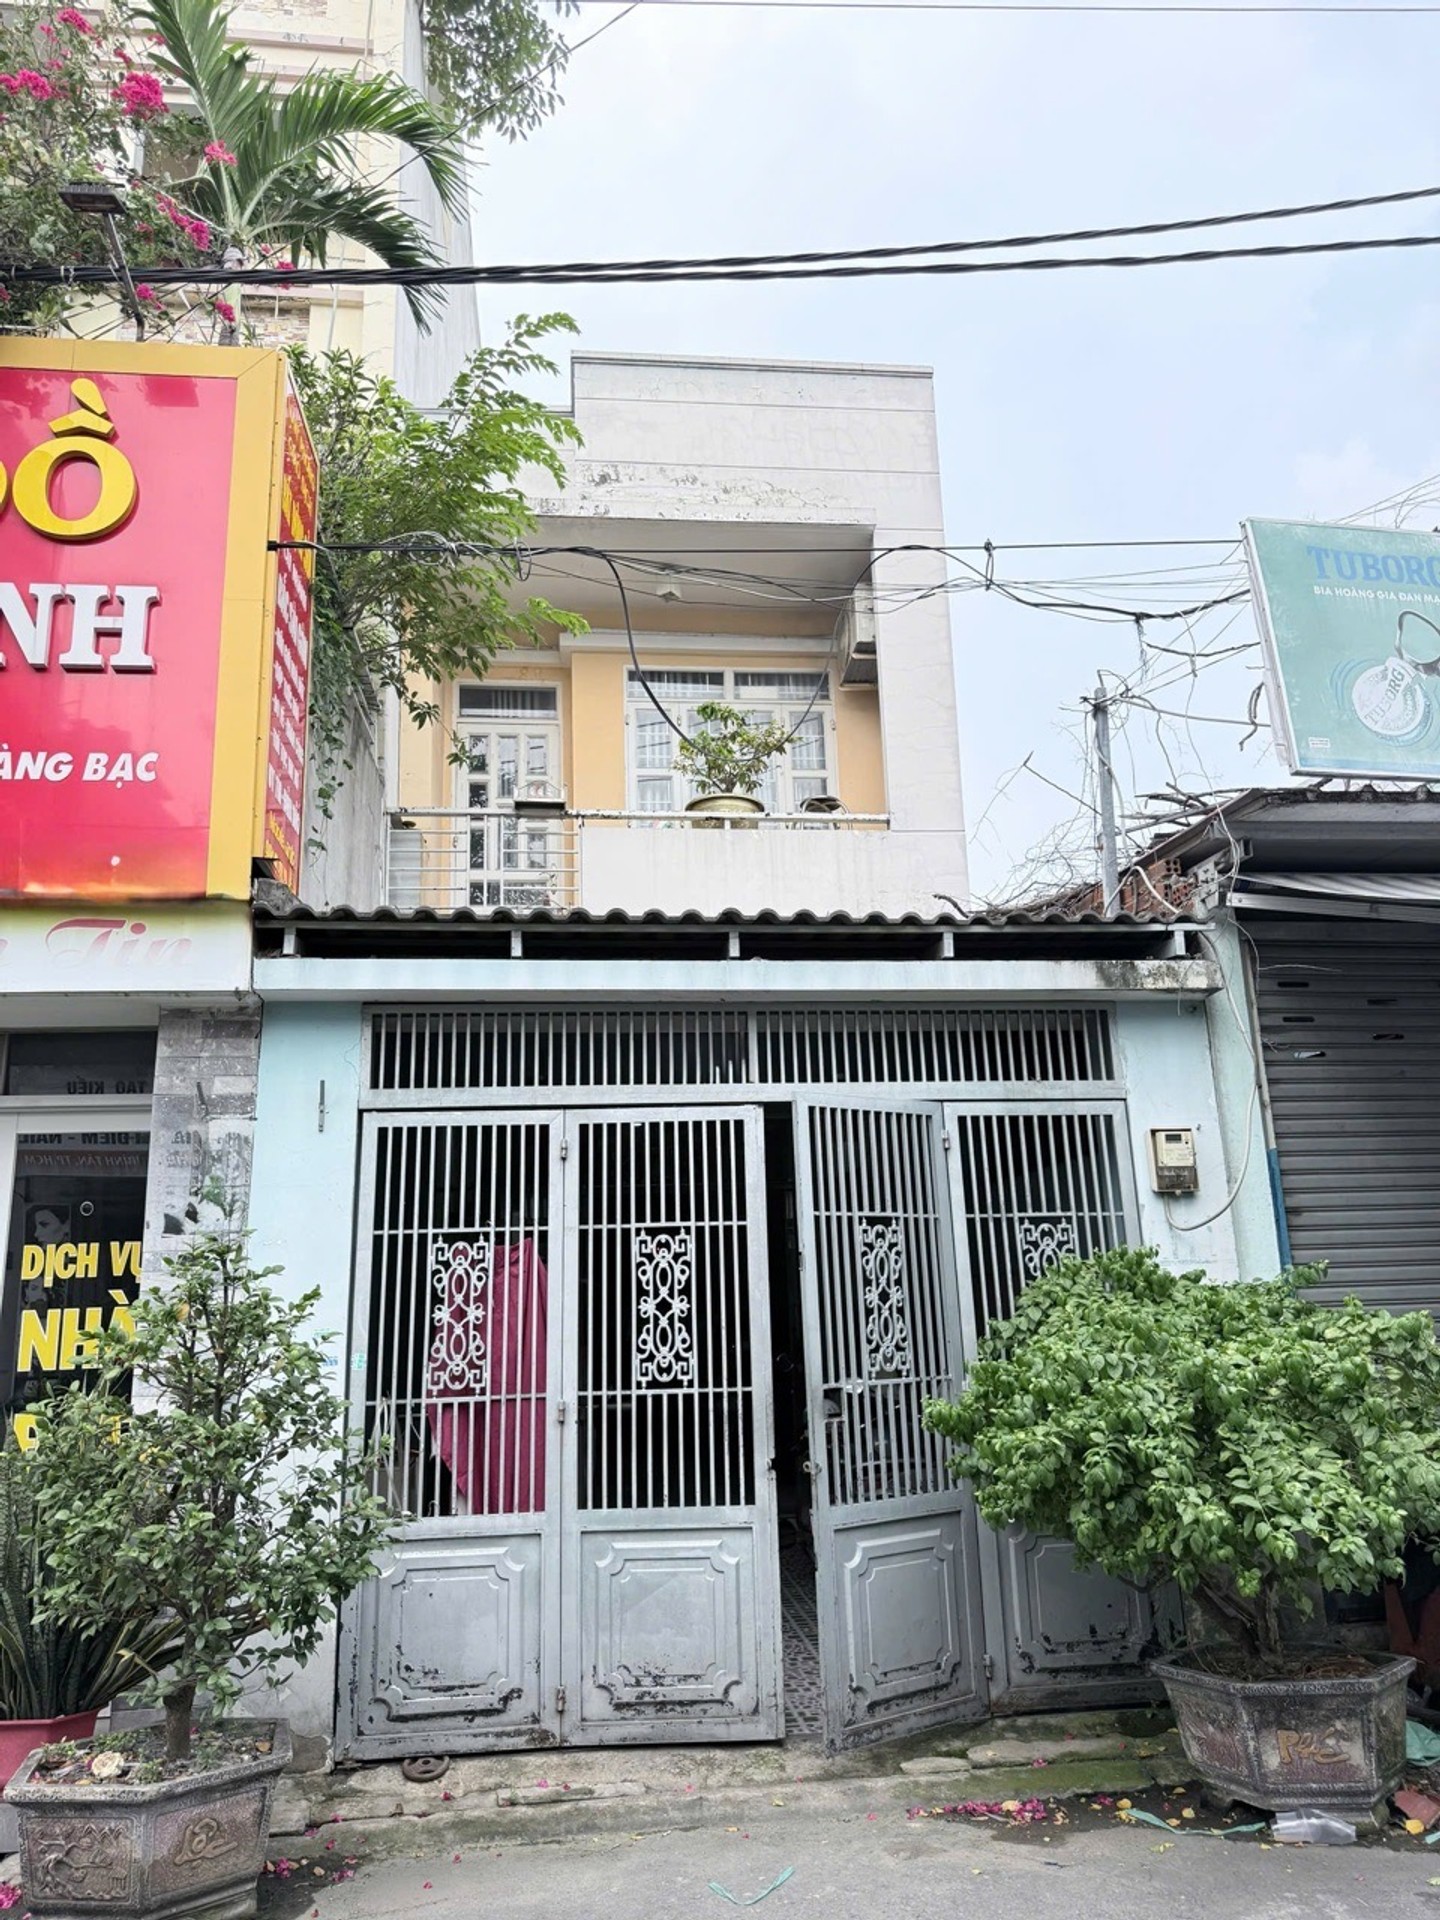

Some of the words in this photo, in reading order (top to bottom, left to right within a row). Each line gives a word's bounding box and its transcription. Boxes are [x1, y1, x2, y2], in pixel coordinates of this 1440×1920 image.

[0, 378, 139, 541] Ồ
[1313, 585, 1333, 596] BIA
[1334, 586, 1374, 599] HOÀNG
[1376, 590, 1397, 600] GIA
[82, 752, 159, 789] BẠC
[45, 917, 193, 970] Tin
[21, 1242, 100, 1288] DỊCH
